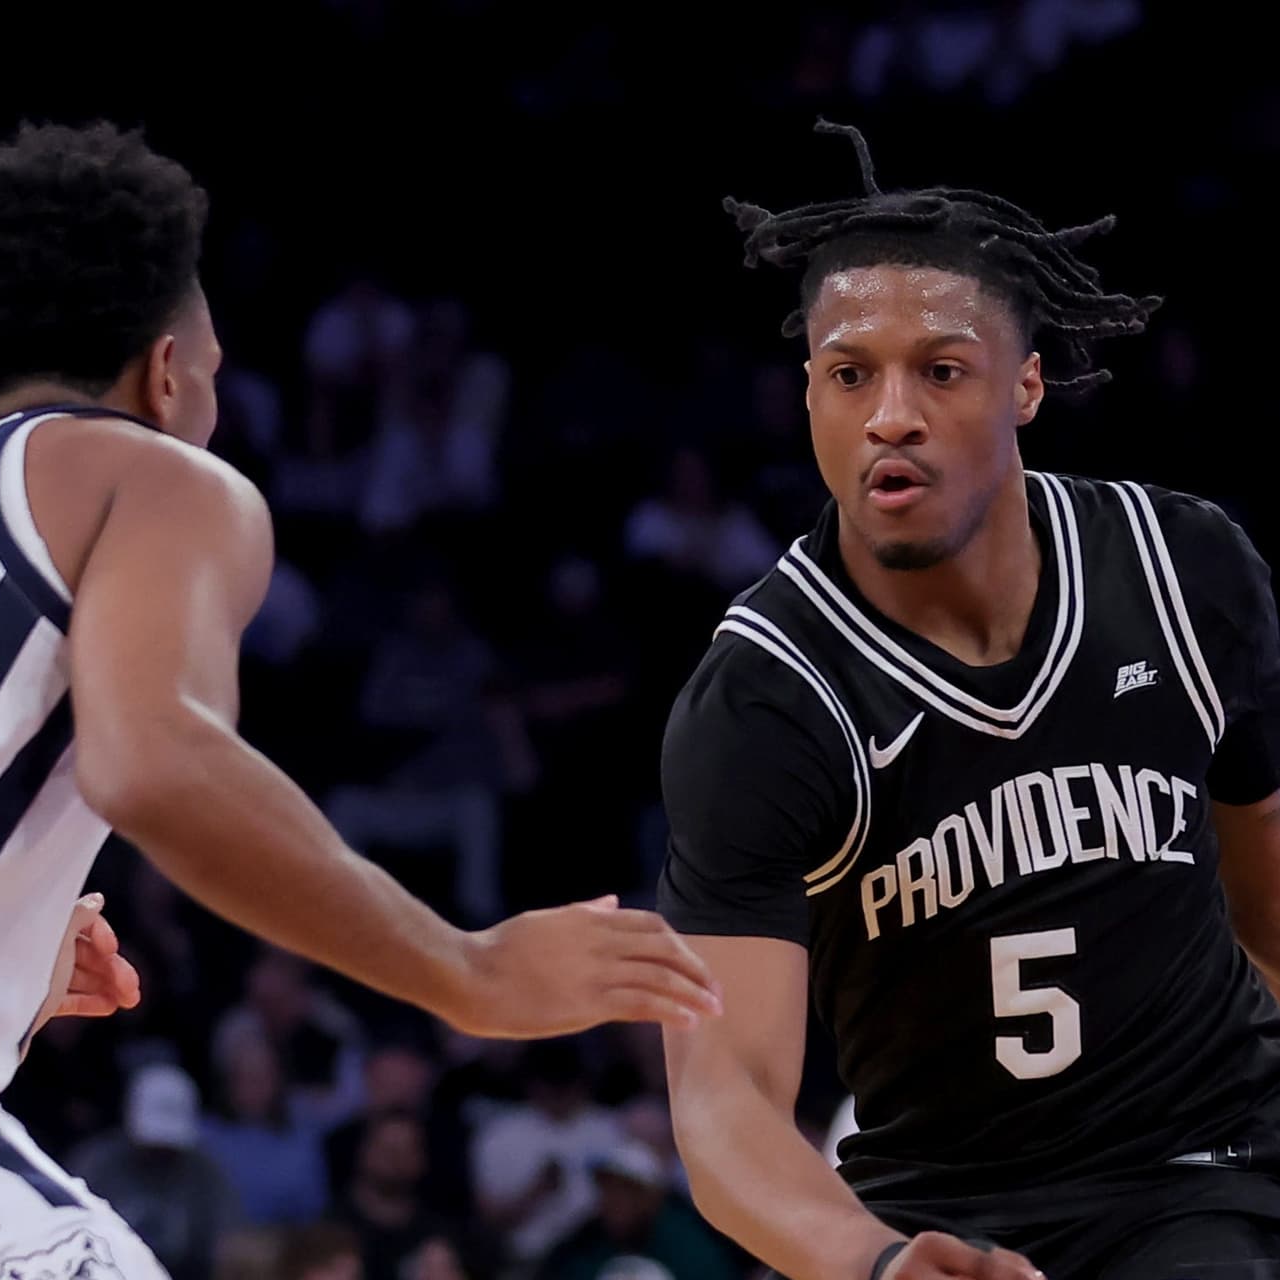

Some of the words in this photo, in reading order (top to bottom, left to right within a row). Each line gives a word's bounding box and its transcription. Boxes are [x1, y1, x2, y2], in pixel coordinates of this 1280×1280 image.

[1115, 669, 1159, 691] EAST
[1117, 660, 1147, 678] BIG
[860, 762, 1198, 942] PROVIDENCE
[990, 927, 1082, 1080] 5
